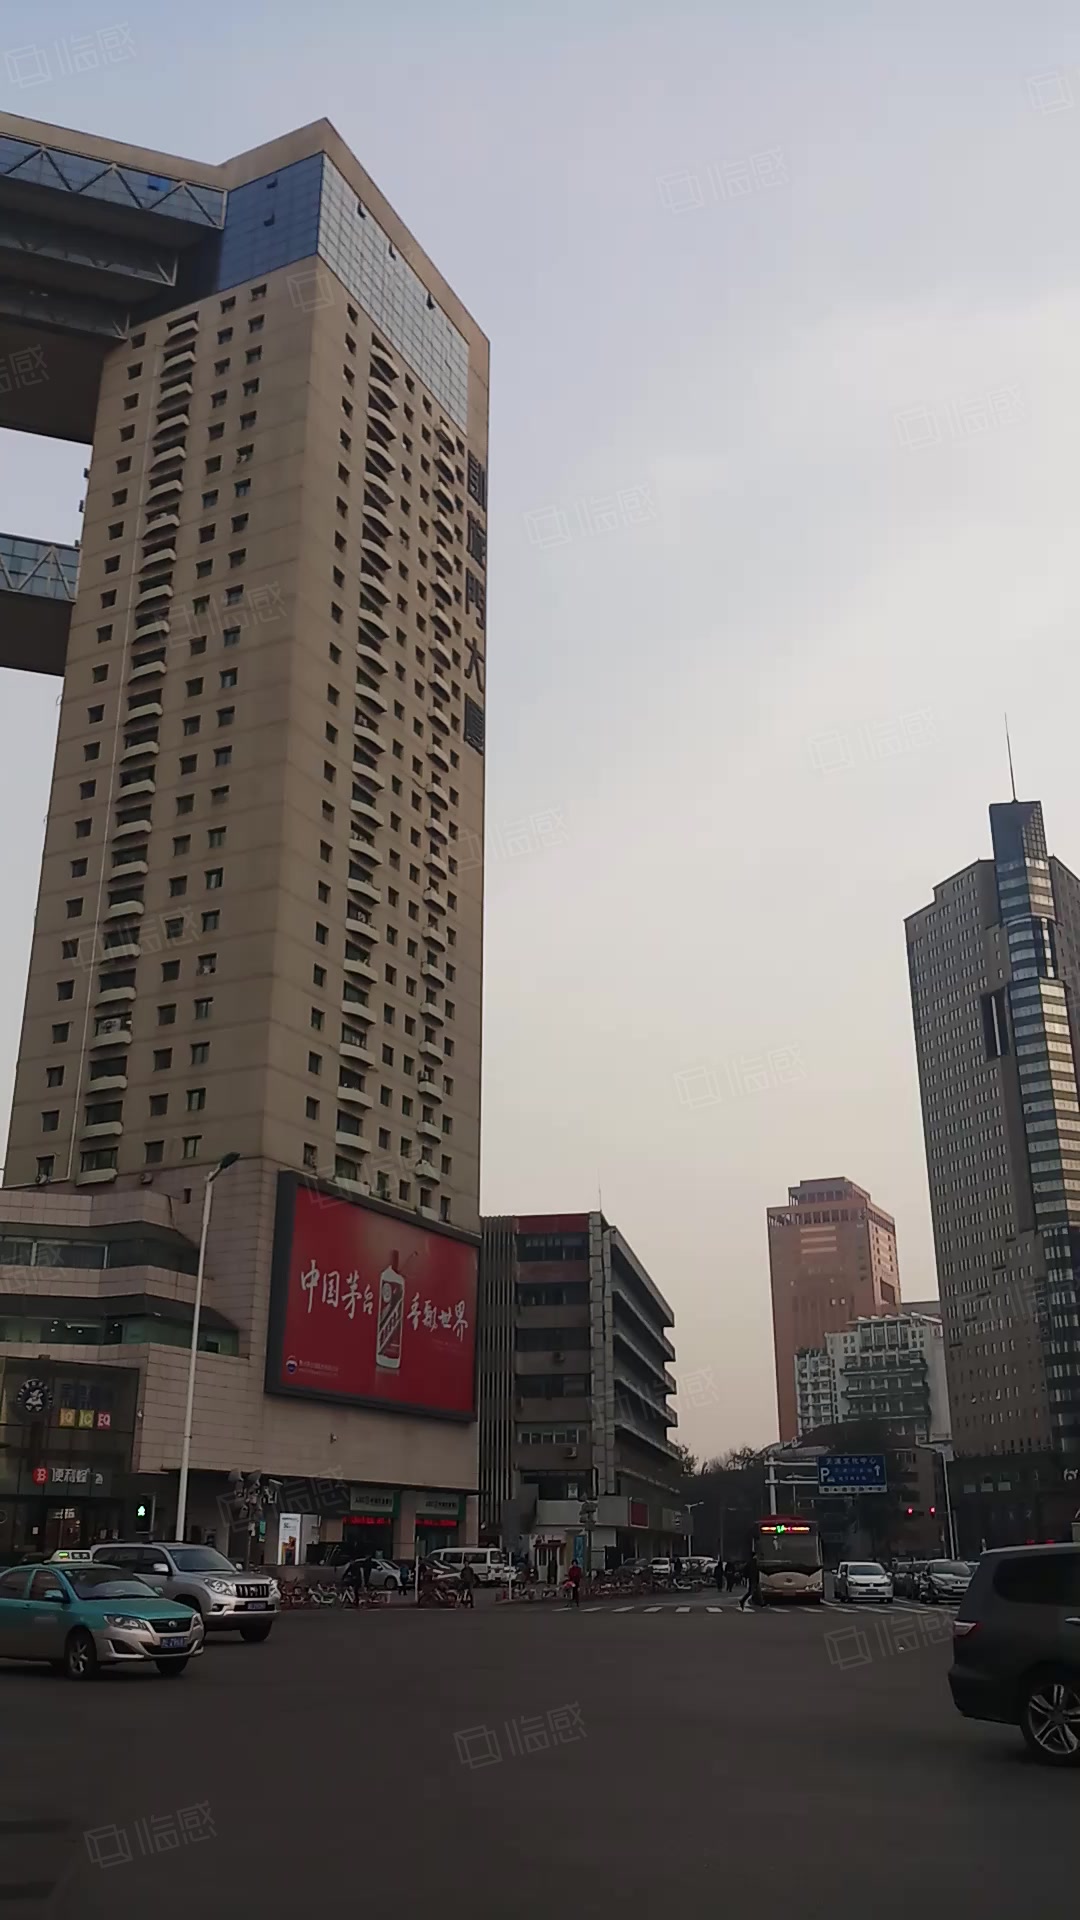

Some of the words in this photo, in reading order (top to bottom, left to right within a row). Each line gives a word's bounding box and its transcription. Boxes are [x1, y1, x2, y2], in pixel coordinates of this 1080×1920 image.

[301, 1259, 373, 1320] 中国茅台
[820, 1467, 830, 1482] P
